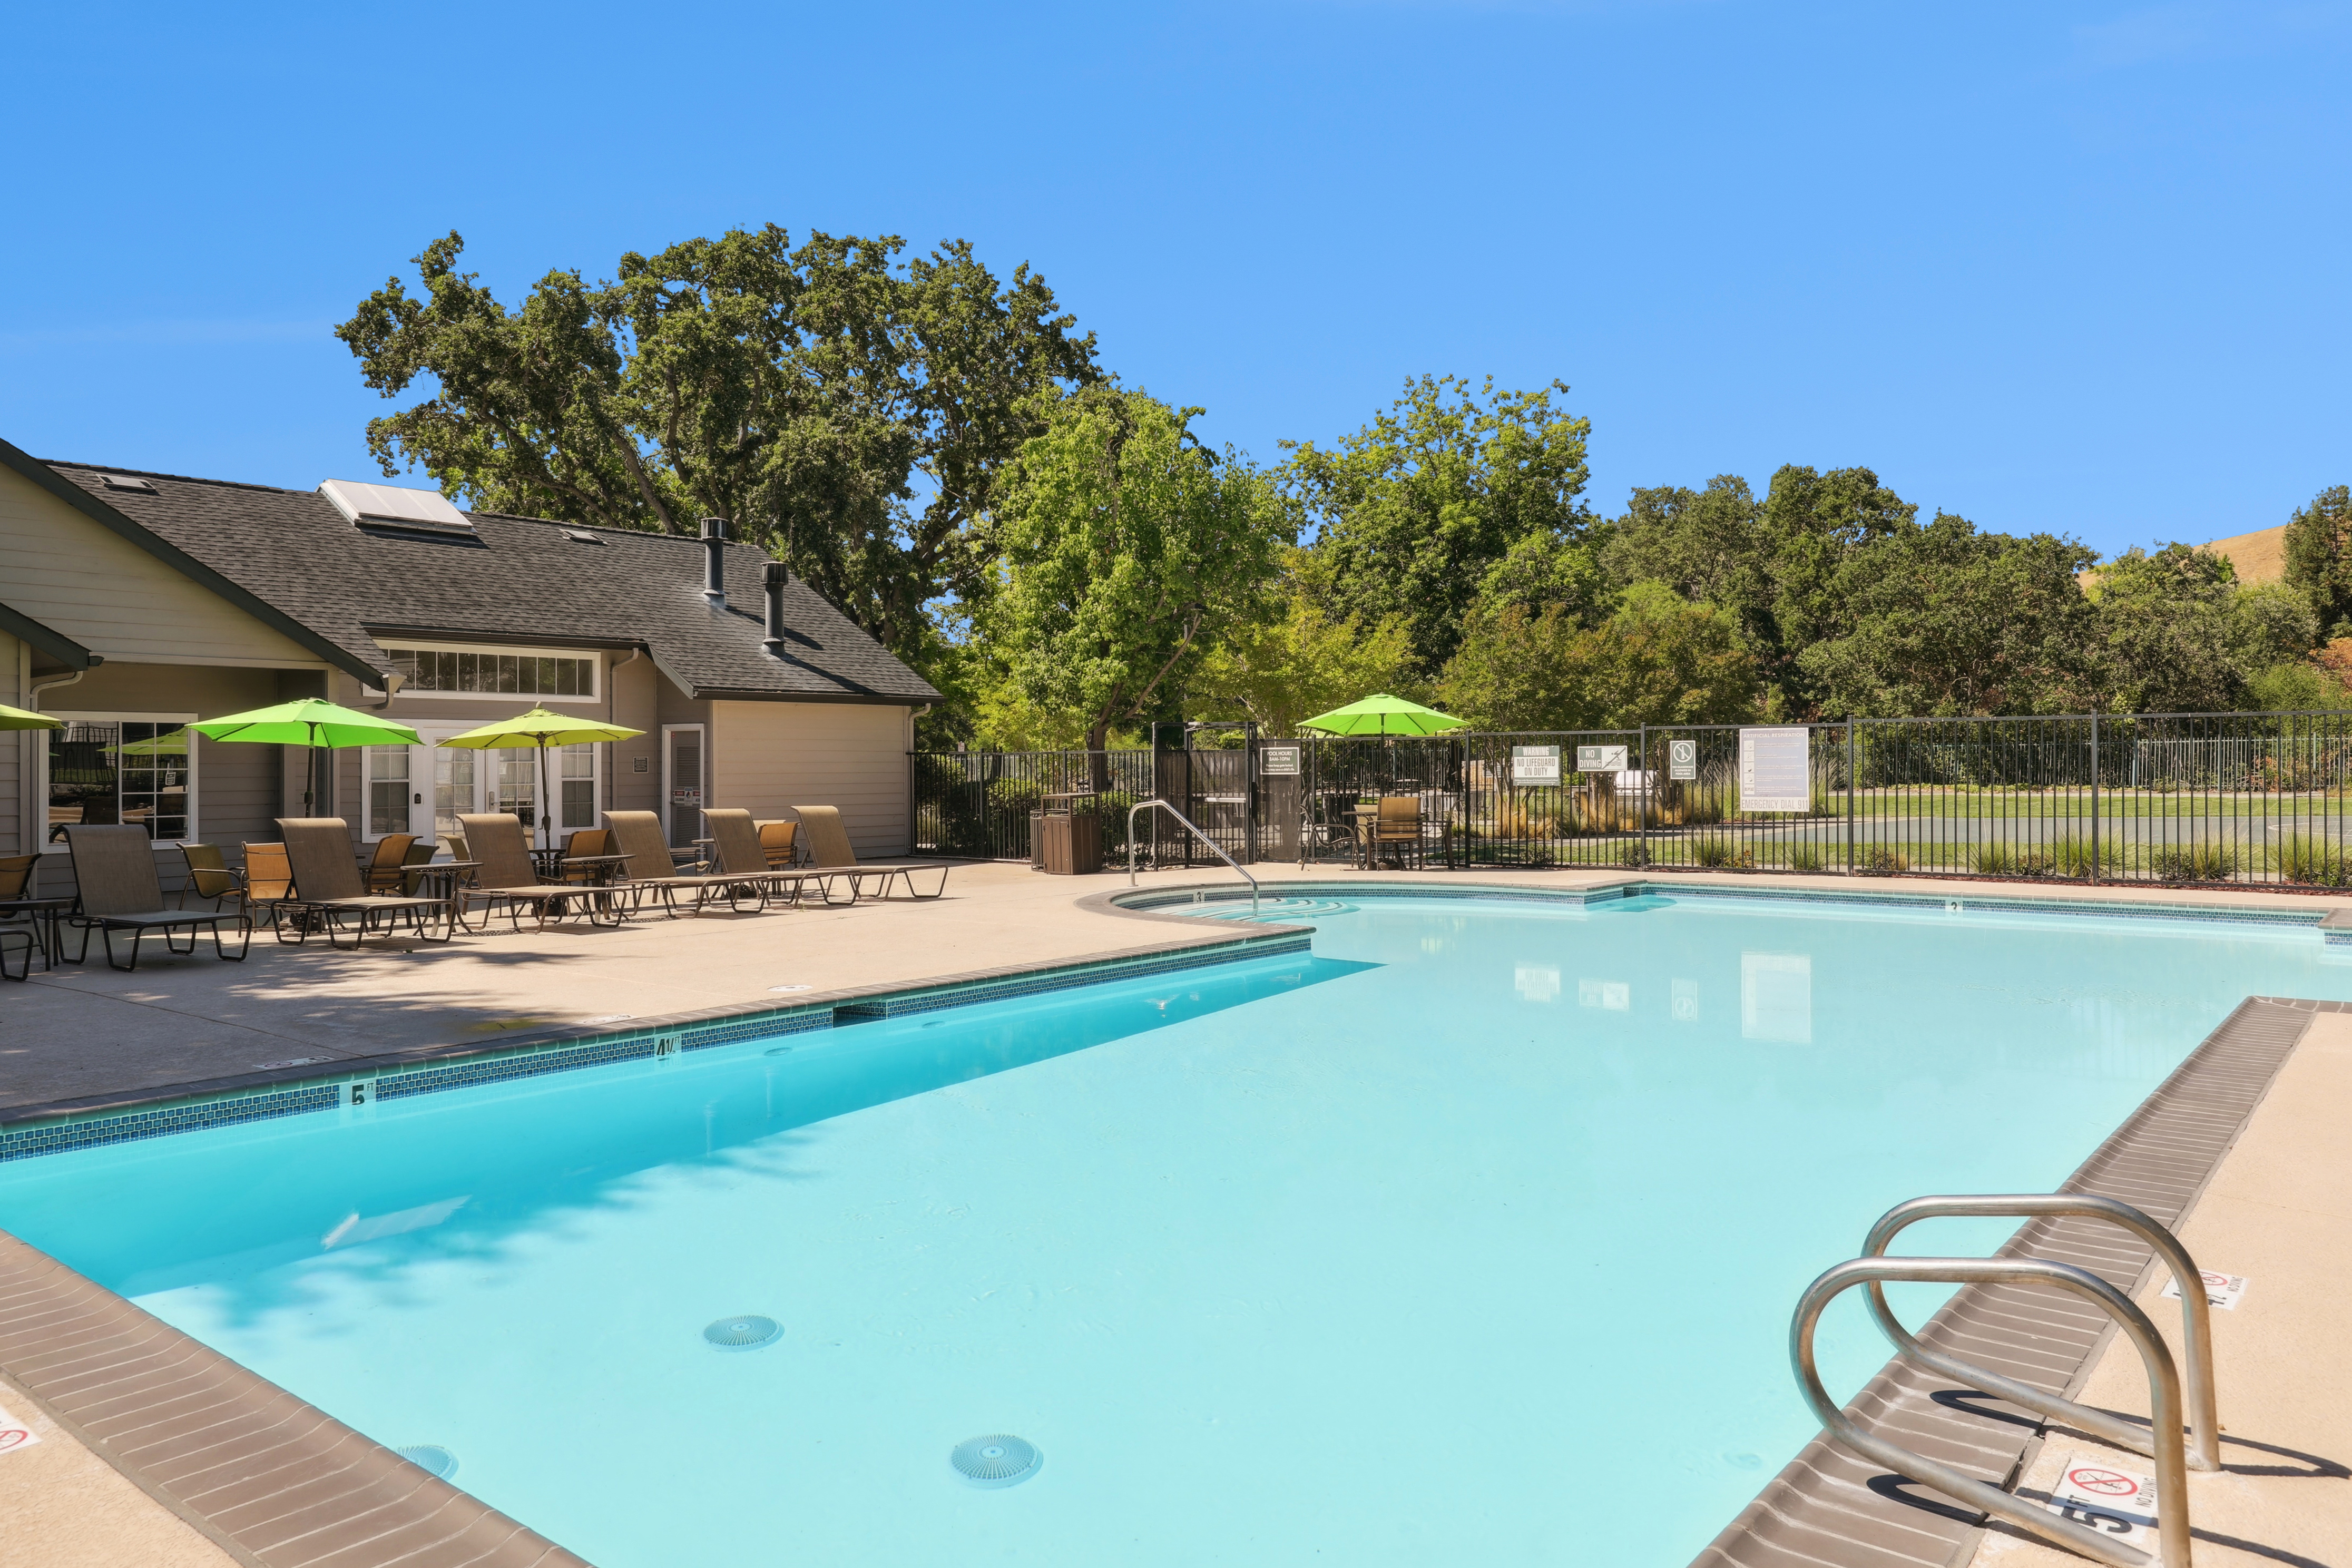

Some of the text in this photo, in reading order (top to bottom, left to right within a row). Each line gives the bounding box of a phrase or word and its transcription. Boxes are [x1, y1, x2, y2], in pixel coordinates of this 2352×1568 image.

[1523, 747, 1550, 756] WARNING
[1517, 758, 1555, 767] NO LIFEGUARD
[1580, 759, 1601, 768] DIVING
[1524, 767, 1548, 776] ON DUTY
[1741, 799, 1808, 809] EMERGENCY DIAL 911
[351, 1082, 374, 1105] 5 FT
[2134, 1477, 2157, 1508] NO DIVING
[2060, 1494, 2132, 1533] 5 FT
